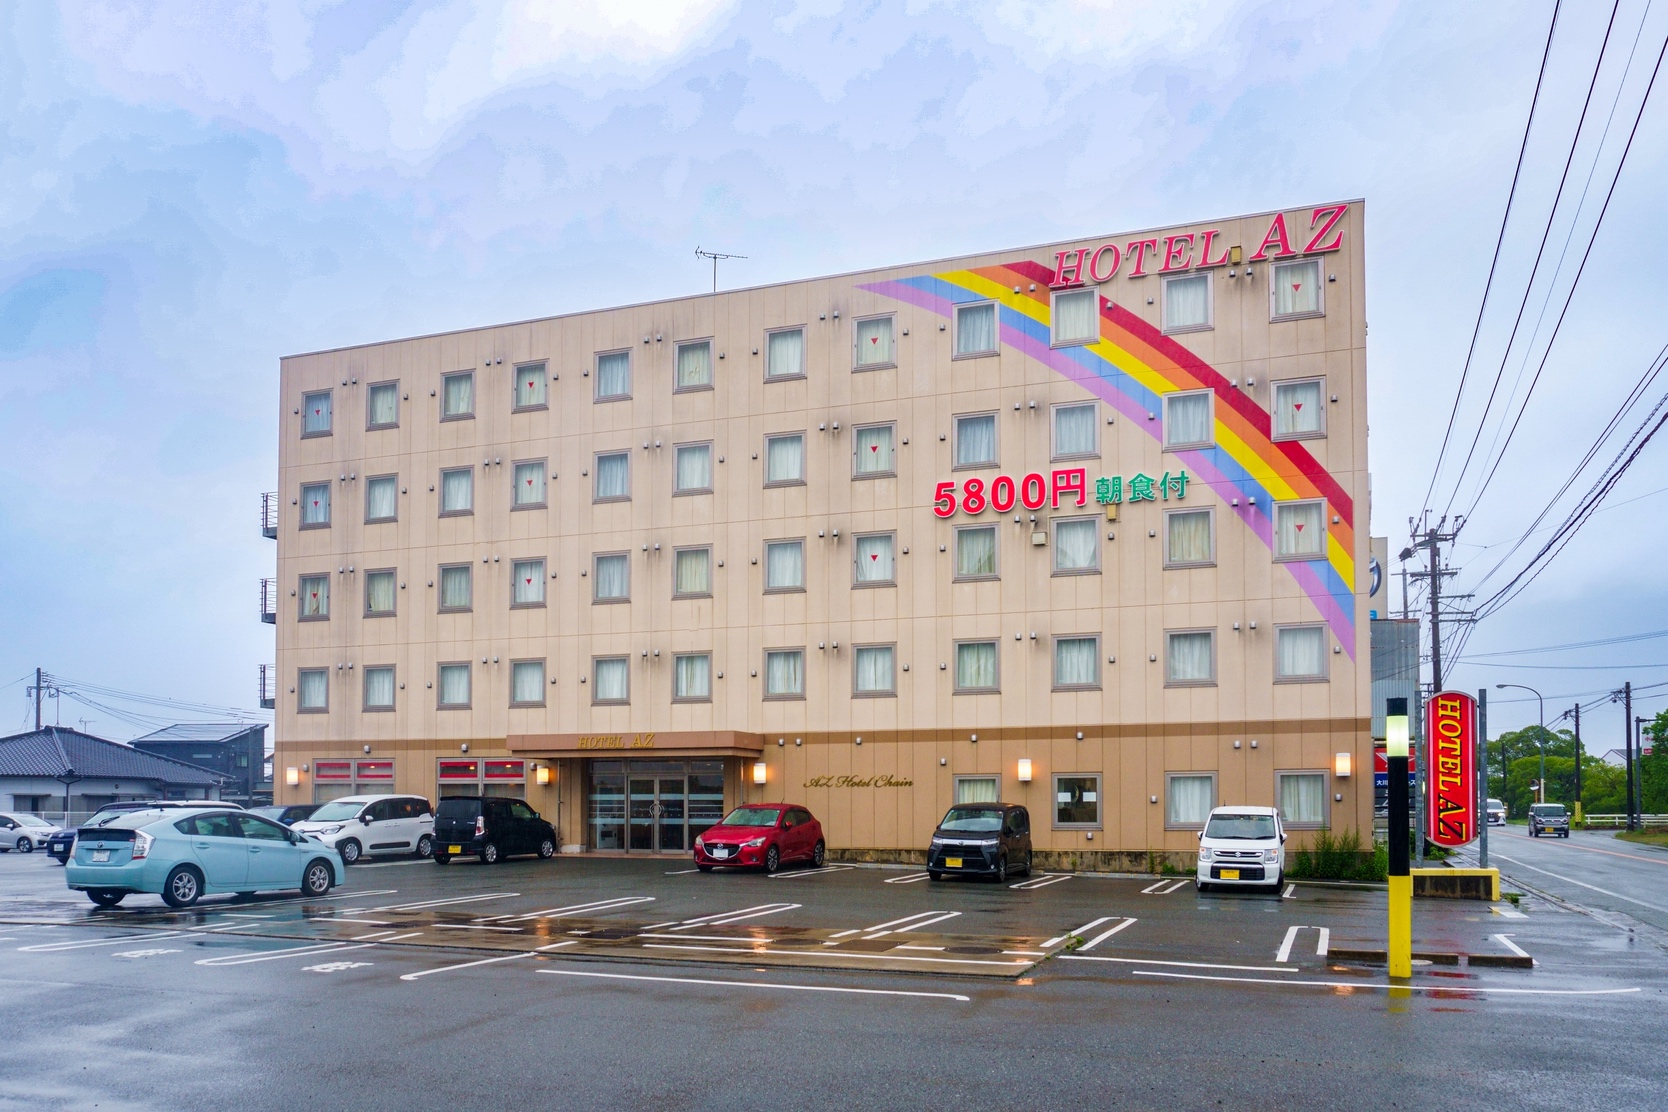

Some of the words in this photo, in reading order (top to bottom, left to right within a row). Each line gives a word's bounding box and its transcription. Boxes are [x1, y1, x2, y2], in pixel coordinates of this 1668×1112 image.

[1048, 229, 1231, 288] HOTEL
[1248, 203, 1348, 262] AZ
[932, 467, 1088, 519] 5800円
[1095, 470, 1190, 504] 朝食付
[577, 736, 626, 750] HOTEL
[630, 732, 655, 749] AZ
[1438, 697, 1462, 791] HOTEL
[803, 775, 834, 788] AZ
[835, 774, 873, 788] Hotel
[873, 774, 914, 788] Chain
[1438, 793, 1467, 841] AZ
